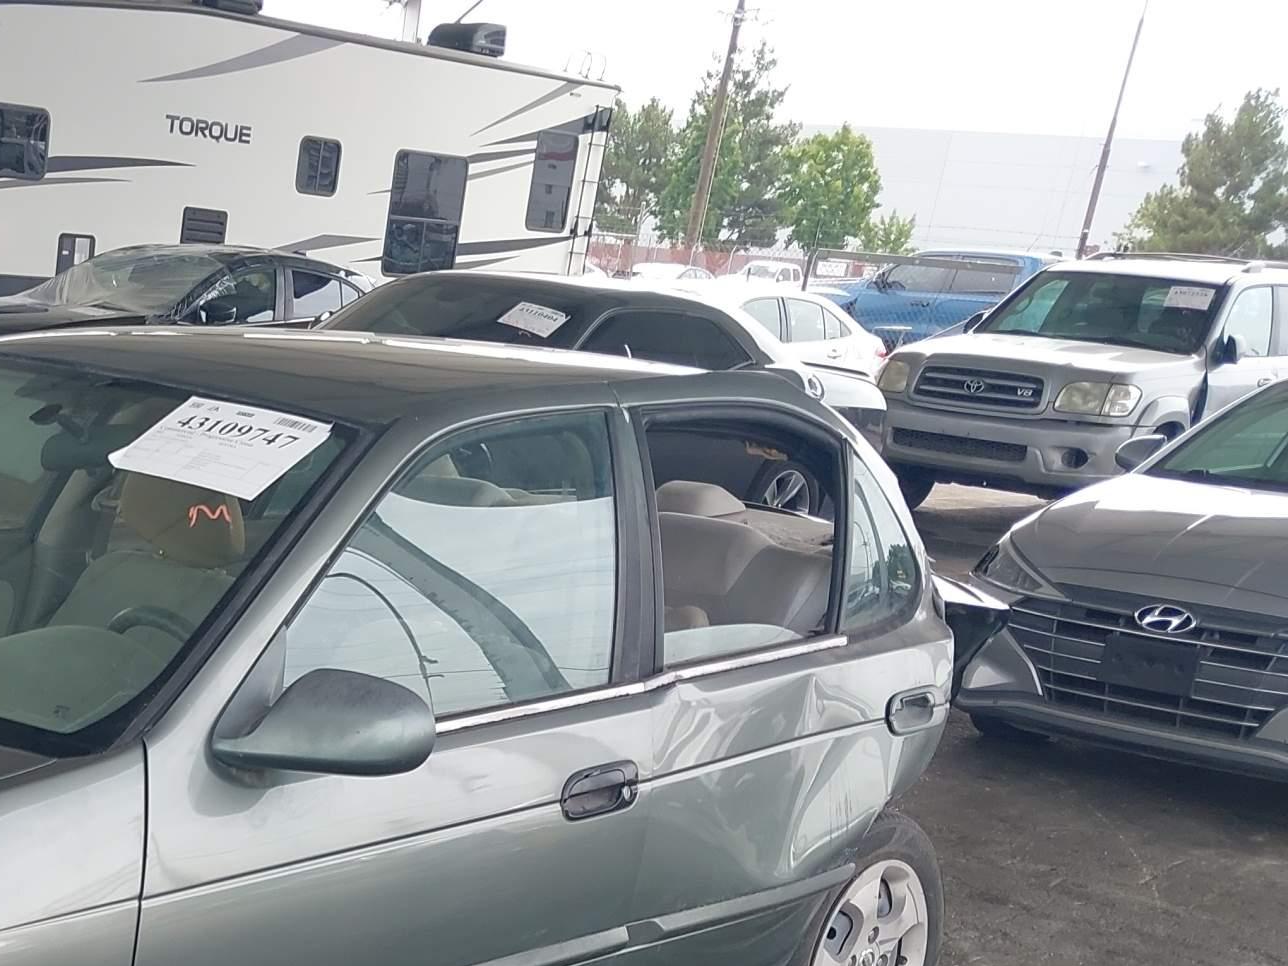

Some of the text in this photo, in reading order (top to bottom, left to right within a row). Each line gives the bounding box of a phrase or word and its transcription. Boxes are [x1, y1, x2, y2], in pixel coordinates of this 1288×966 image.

[165, 113, 252, 145] TORQUE
[1017, 387, 1034, 397] V8
[177, 414, 301, 449] 43109747
